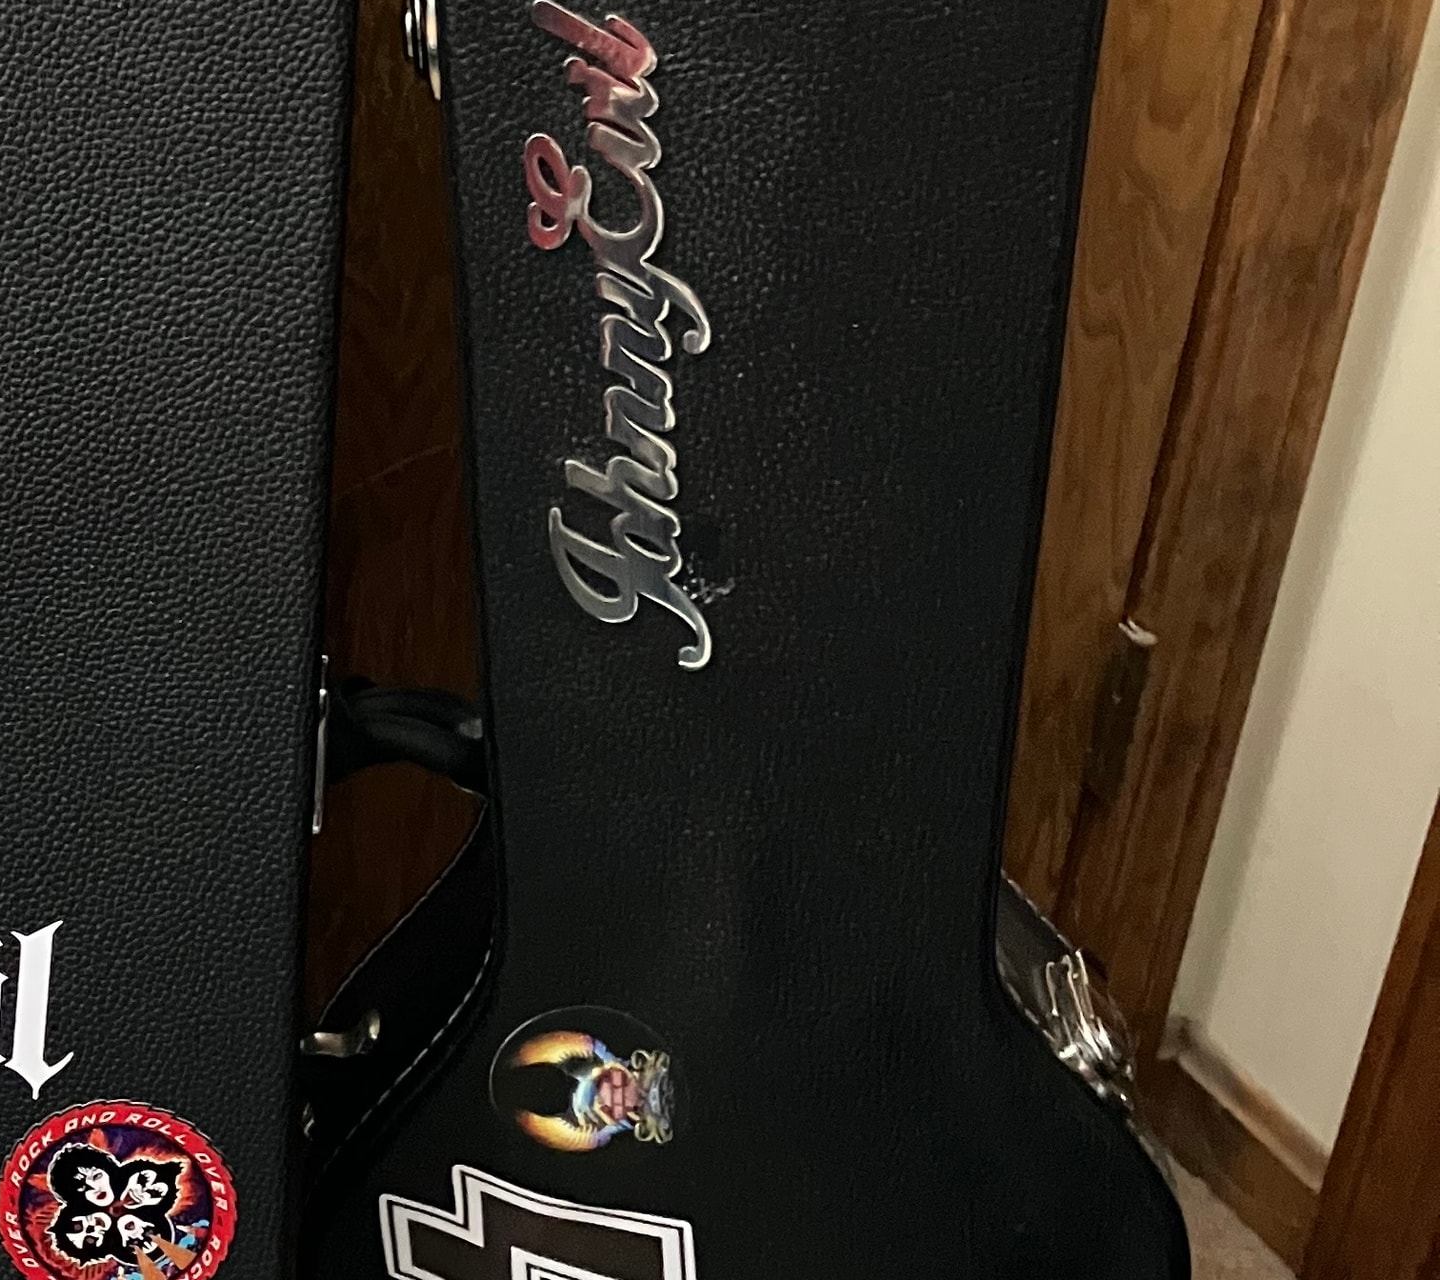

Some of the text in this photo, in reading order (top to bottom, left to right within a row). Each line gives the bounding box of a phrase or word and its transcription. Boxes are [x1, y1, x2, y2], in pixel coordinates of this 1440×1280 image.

[549, 263, 712, 671] Johnny
[10, 1111, 229, 1211] ROCK AND ROLL OVER
[5, 1211, 40, 1269] OVER
